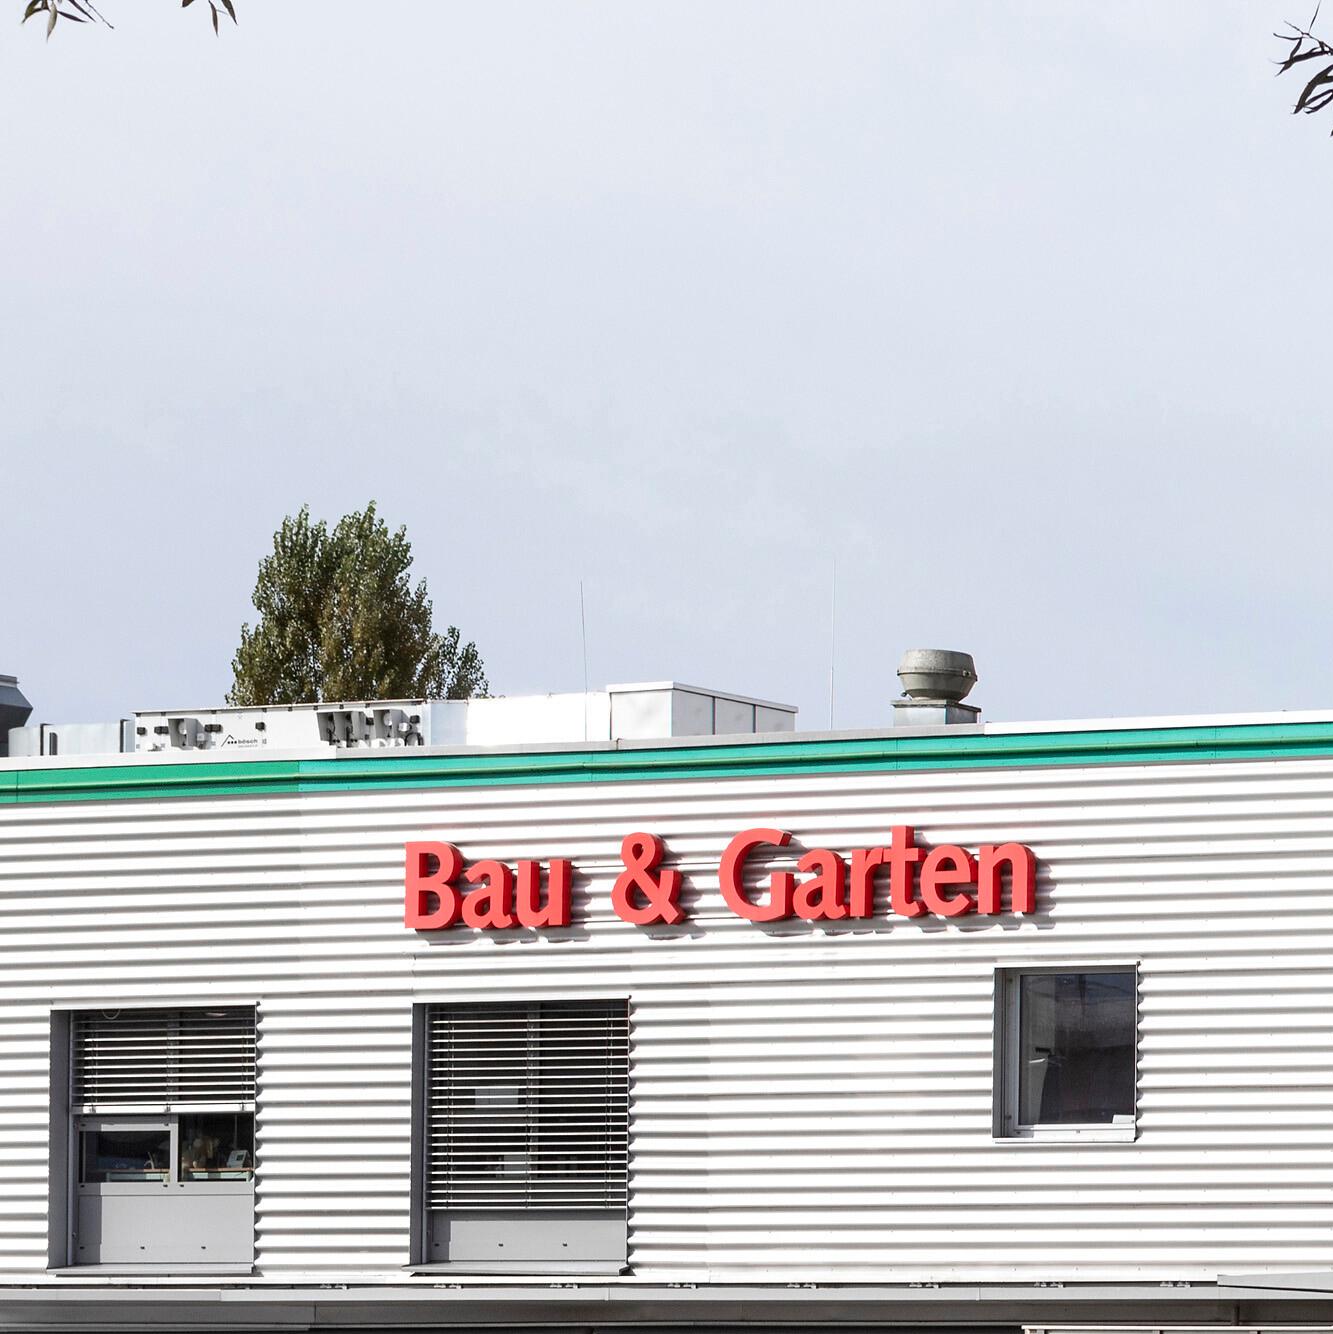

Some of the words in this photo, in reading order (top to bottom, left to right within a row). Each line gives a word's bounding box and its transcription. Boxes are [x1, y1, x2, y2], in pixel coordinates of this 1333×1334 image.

[405, 841, 572, 930] Bau
[611, 831, 684, 925] &
[718, 824, 1036, 922] Garten
